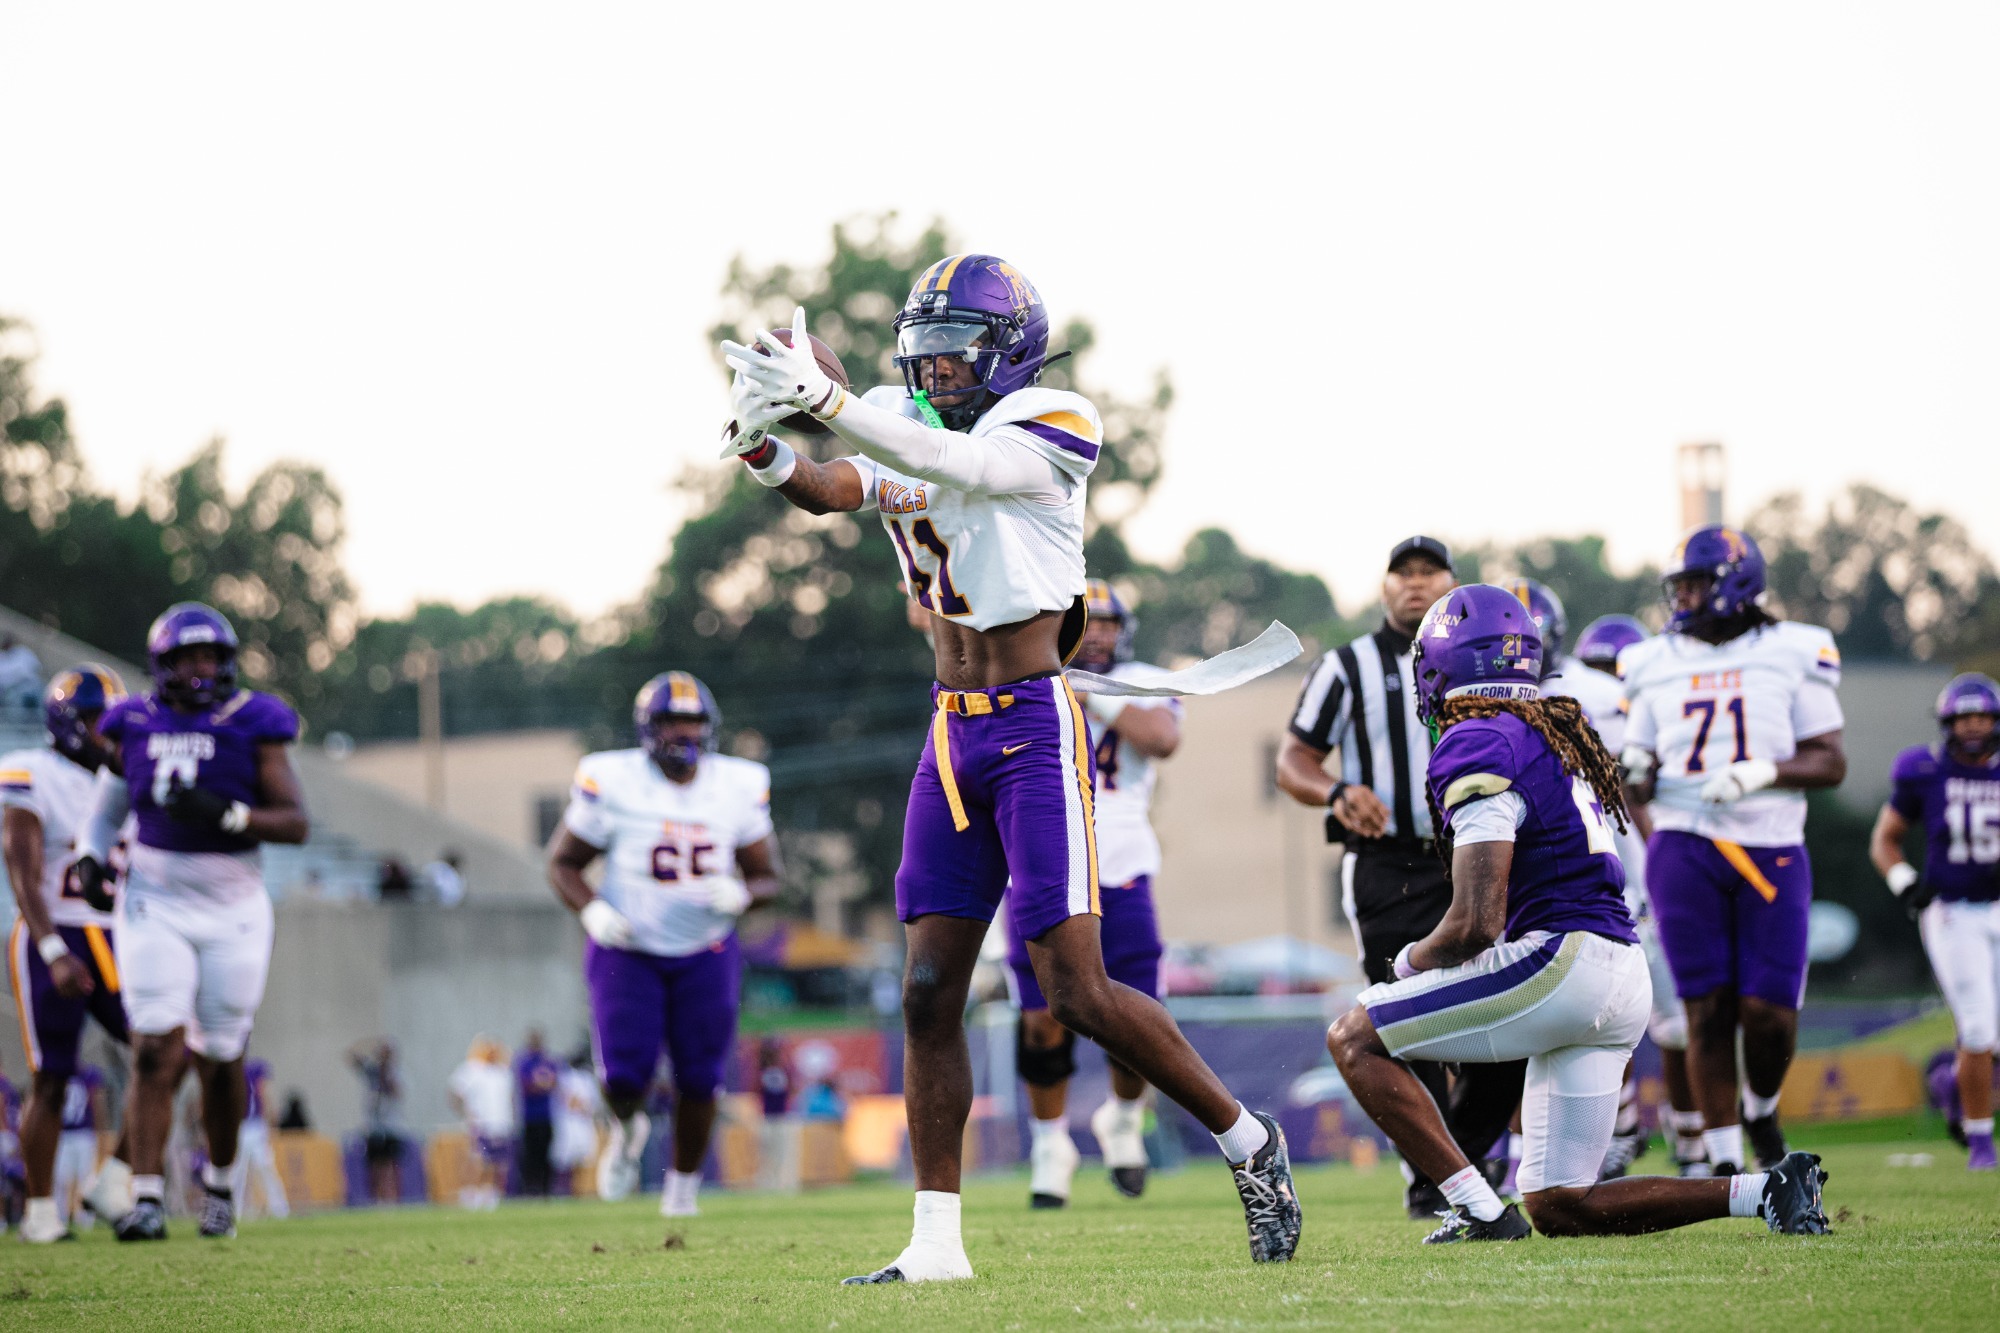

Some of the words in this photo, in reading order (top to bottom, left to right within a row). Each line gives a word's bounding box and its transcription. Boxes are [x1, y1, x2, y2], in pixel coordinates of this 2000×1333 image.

[922, 293, 934, 302] F7
[879, 478, 928, 515] MILES
[889, 516, 974, 618] 11
[1502, 633, 1522, 656] 21
[1683, 696, 1753, 775] 71
